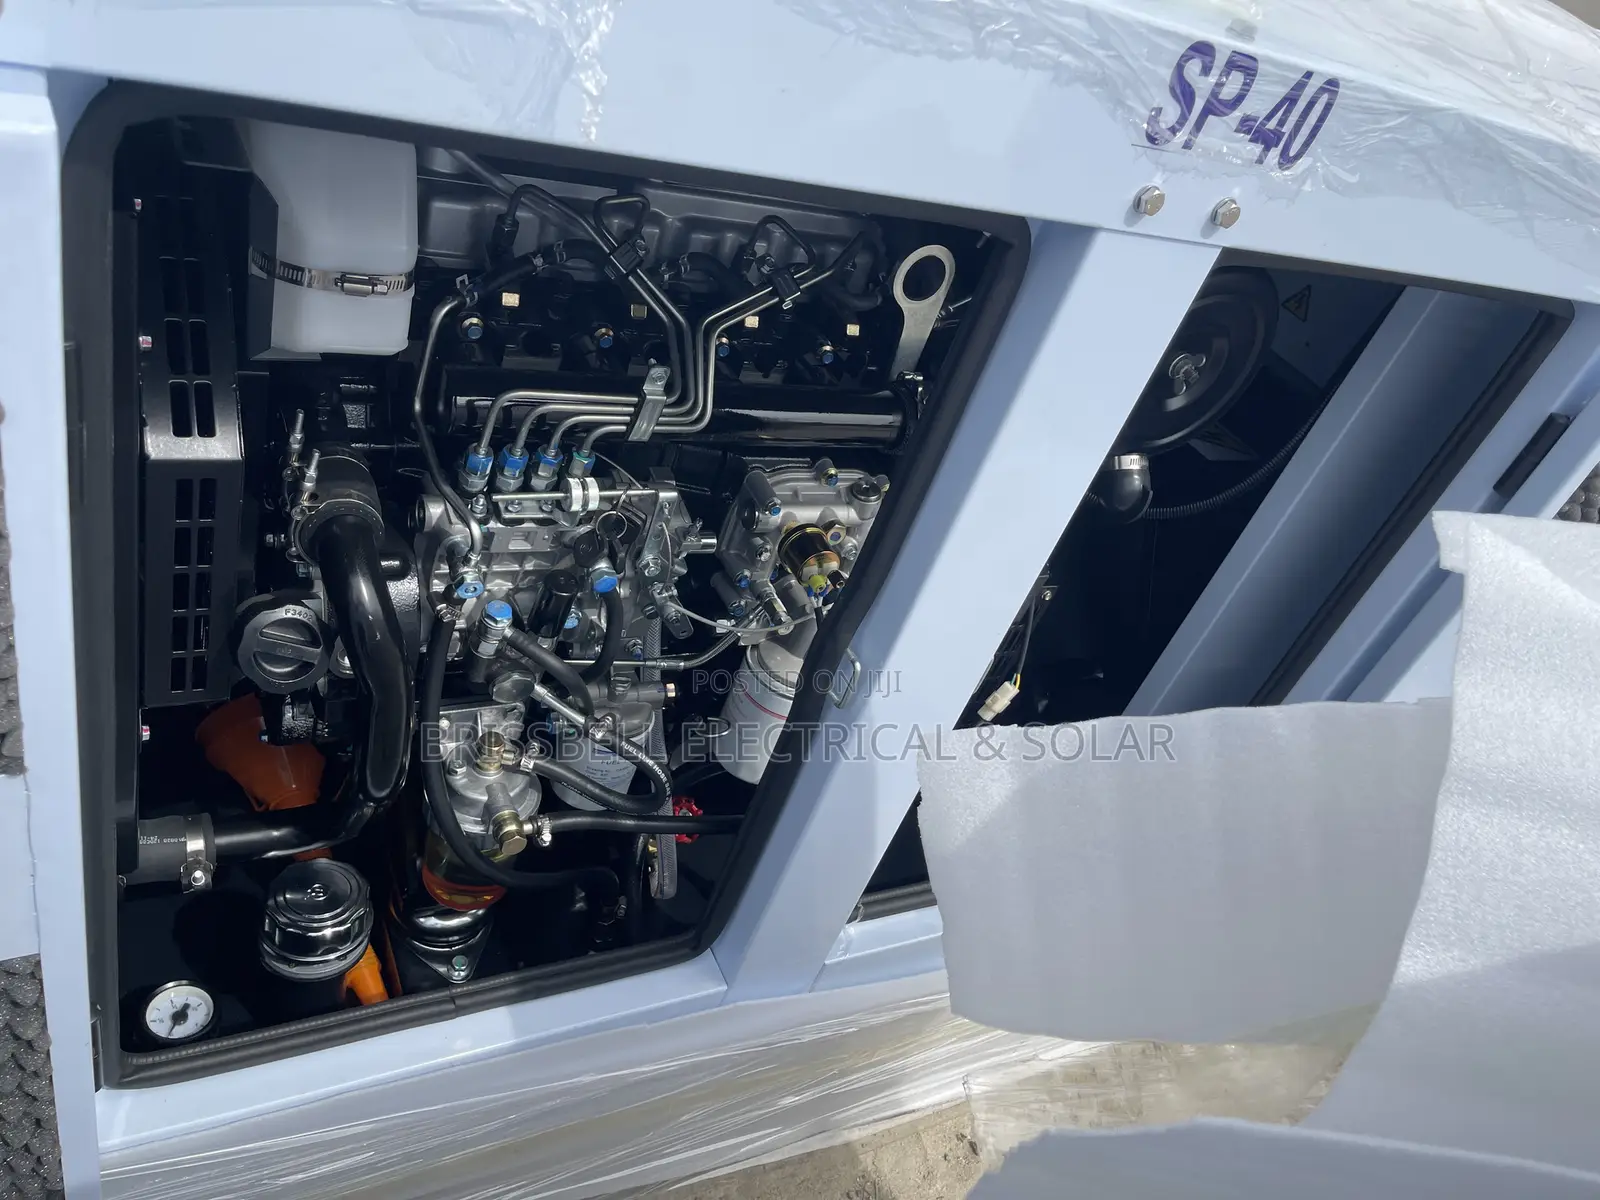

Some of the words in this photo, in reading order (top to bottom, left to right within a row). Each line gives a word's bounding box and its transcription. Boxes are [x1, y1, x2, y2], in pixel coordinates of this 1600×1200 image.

[1145, 39, 1340, 171] SP-40
[284, 607, 313, 622] F3402
[620, 741, 637, 756] FUEL
[638, 752, 655, 766] LINE
[654, 765, 668, 783] HOSE
